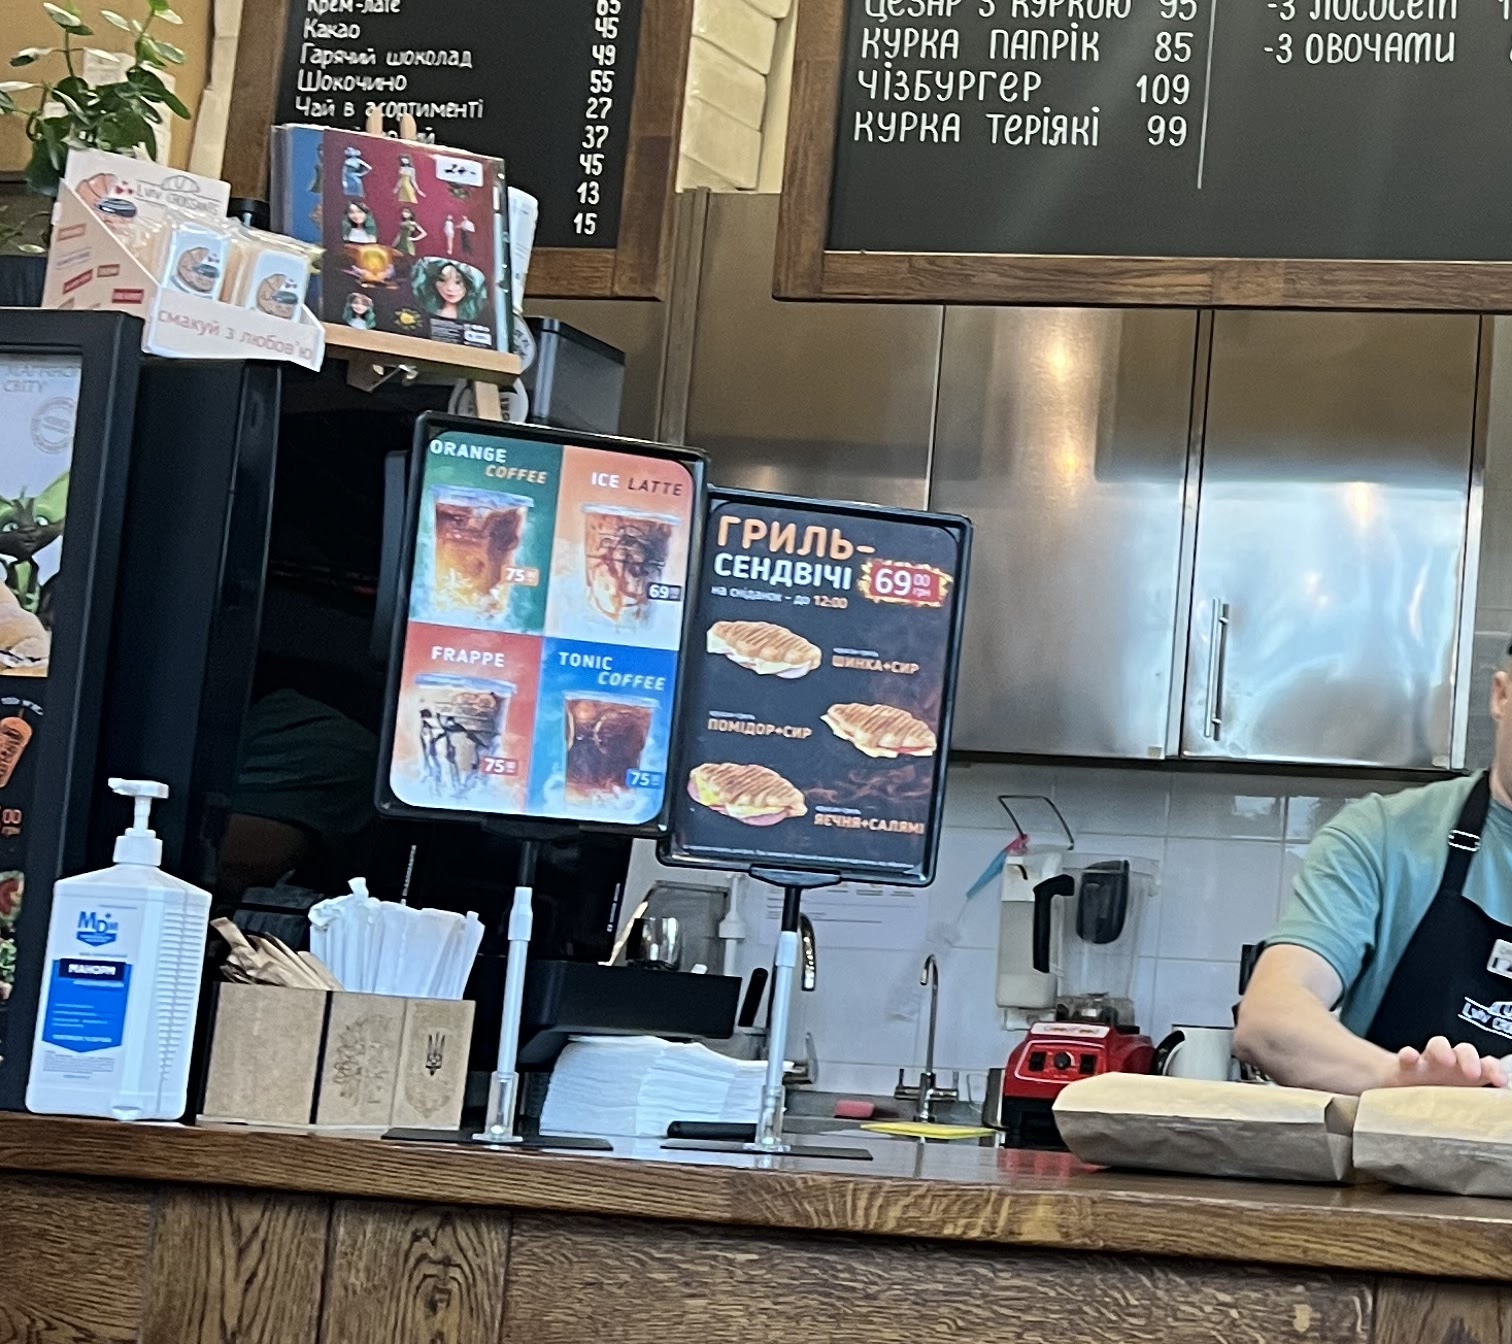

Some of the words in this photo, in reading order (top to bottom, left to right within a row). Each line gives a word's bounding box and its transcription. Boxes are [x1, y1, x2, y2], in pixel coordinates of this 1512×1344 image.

[304, 18, 360, 38] Какао
[862, 28, 958, 59] КУРКА
[990, 22, 1099, 61] ПАПРІК
[1306, 32, 1454, 64] ОВОЧАМИ
[300, 43, 375, 69] Гарячий
[387, 50, 472, 68] шоколад
[298, 69, 407, 91] Шокочино
[859, 62, 1041, 102] ЧІЗБУРГЕР
[1137, 74, 1189, 104] 109
[296, 97, 335, 117] Чай
[854, 111, 960, 142] КУРКА
[986, 107, 1099, 146] ТЕРІЯКІ
[574, 213, 597, 234] 15
[157, 310, 221, 337] смакуй
[429, 439, 507, 463] ORANGE
[485, 464, 548, 484] COFFEE
[591, 472, 620, 488] ICE
[628, 477, 683, 496] LATTE
[717, 515, 876, 560] ГРИЛЬ-
[505, 568, 526, 582] 75
[713, 552, 852, 590] СЕНДВІЧІ
[650, 585, 669, 599] 69
[874, 568, 911, 596] 69
[431, 646, 505, 667] FRAPPE
[559, 651, 613, 671] TONIC
[831, 655, 920, 675] ШИНКА+СИР
[597, 671, 666, 691] COFFEE
[707, 718, 813, 739] ПОМІДОР+СИР
[485, 759, 505, 773] 75
[630, 772, 650, 786] 75
